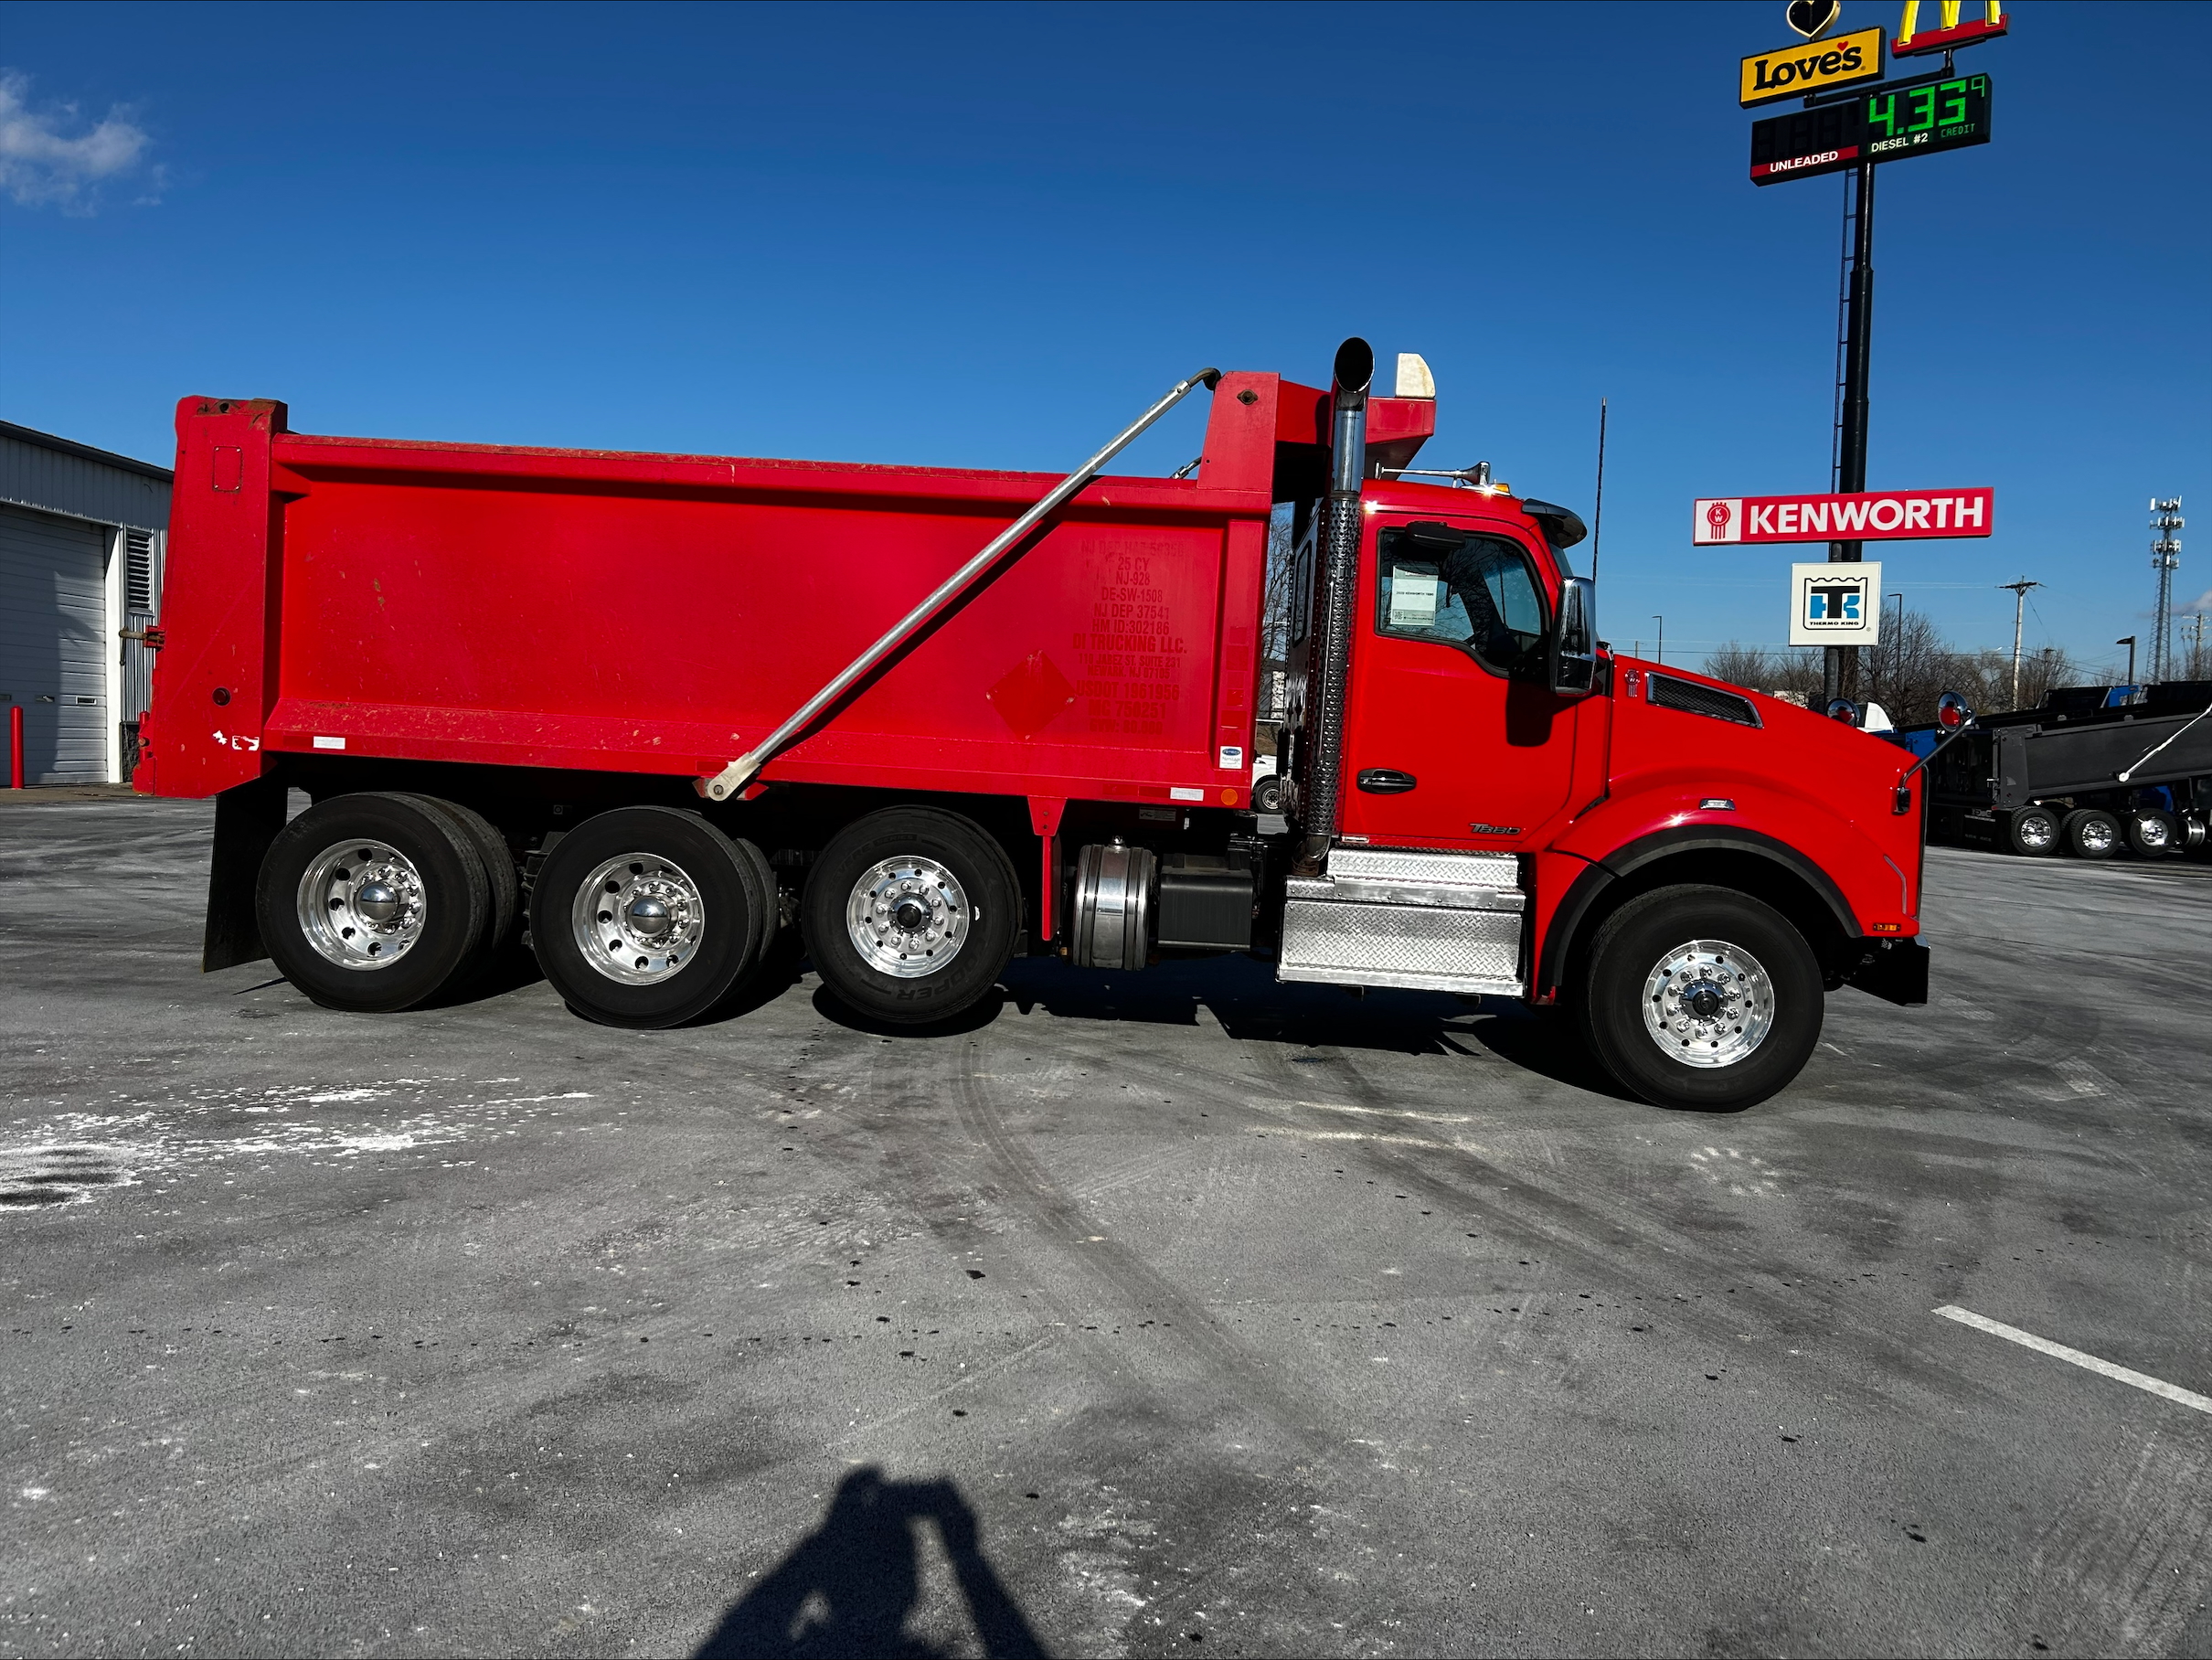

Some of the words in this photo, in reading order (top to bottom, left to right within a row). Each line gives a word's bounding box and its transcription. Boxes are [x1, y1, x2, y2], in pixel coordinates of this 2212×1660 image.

[1868, 80, 1967, 137] 4.33
[1941, 122, 1976, 138] CREDIT
[1871, 138, 1909, 153] DIESEL
[1913, 133, 1929, 145] #2
[1770, 150, 1838, 173] UNLEADED
[1749, 496, 1983, 535] KENWORTH
[1117, 556, 1132, 570] 25
[1134, 557, 1150, 571] CY
[1116, 571, 1150, 585] NJ-928
[1101, 587, 1163, 602] DE-SW-1508
[1094, 602, 1108, 617] NJ
[1111, 604, 1133, 618] DEP
[1136, 604, 1170, 620] 37541
[1092, 619, 1111, 633] HM
[1114, 620, 1170, 635] ID:302186
[1072, 633, 1086, 649] DI
[1090, 633, 1156, 653] TRUCKING
[1160, 636, 1187, 654] LLC.
[1096, 654, 1123, 665] JABEZ
[1125, 654, 1136, 666] ST.
[1139, 655, 1163, 667] SUITE
[1164, 656, 1181, 668] 231
[1129, 666, 1142, 678] NJ
[1143, 667, 1171, 679] 07105
[1076, 680, 1119, 698] USDOT
[1123, 682, 1180, 700] 1961956
[1088, 699, 1111, 717] MC
[1115, 700, 1166, 719] 750251
[1469, 823, 1521, 835] T880
